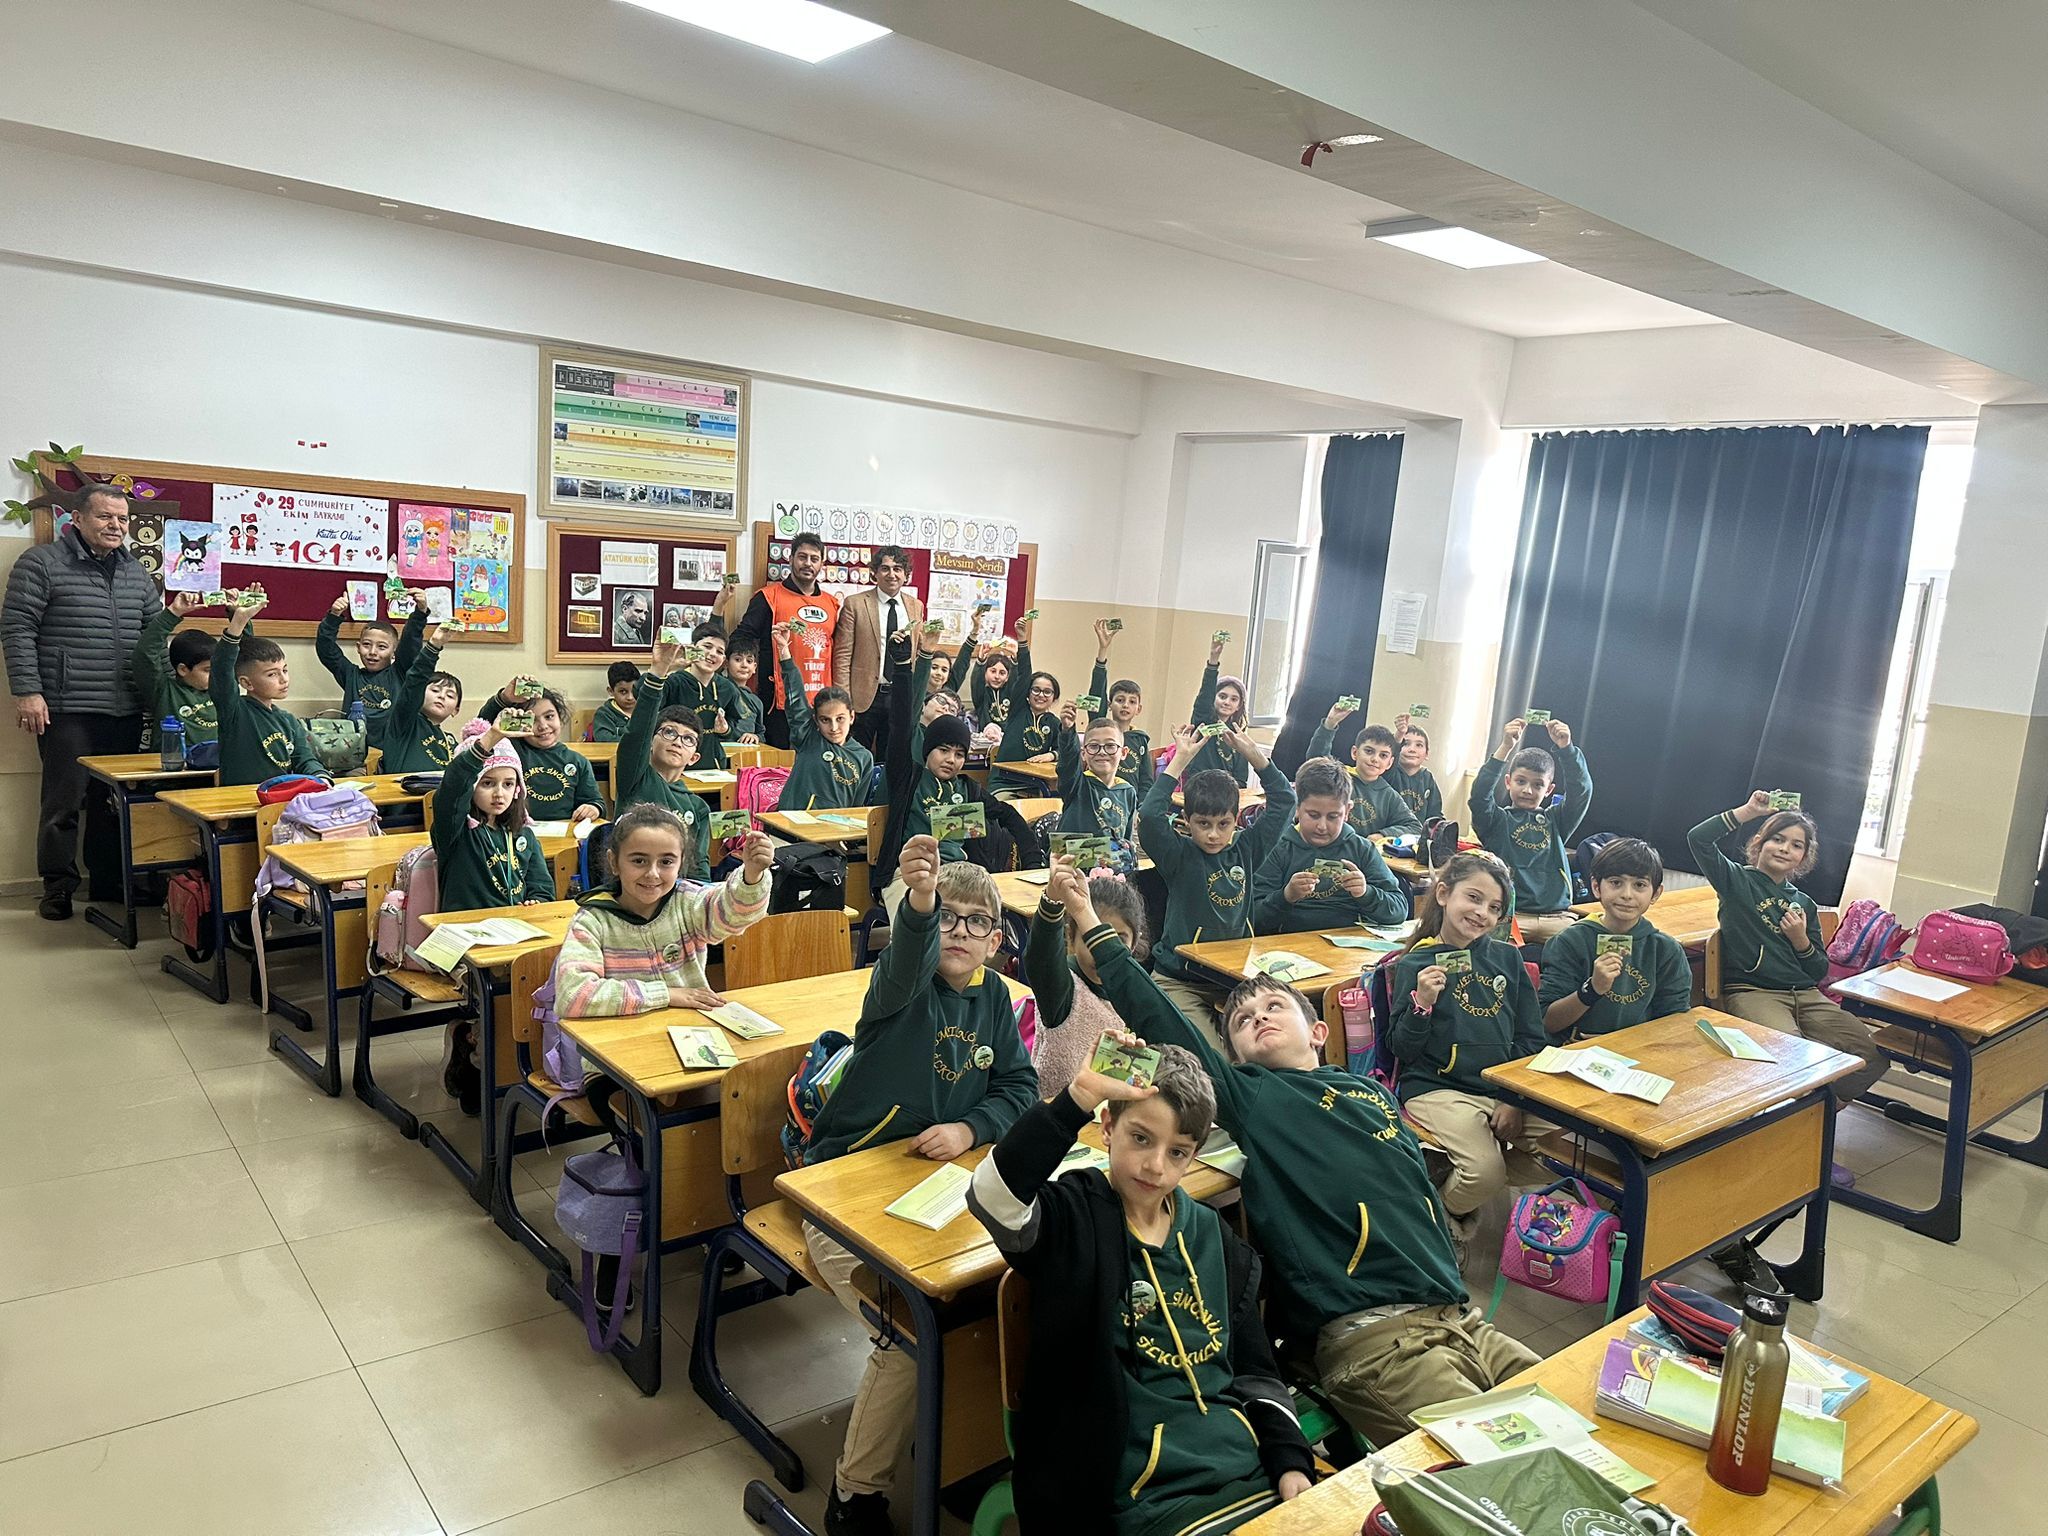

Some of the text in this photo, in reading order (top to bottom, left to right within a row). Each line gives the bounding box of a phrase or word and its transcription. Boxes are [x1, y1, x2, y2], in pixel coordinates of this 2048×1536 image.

[278, 495, 355, 511] 29 CUMHURİYET
[283, 510, 345, 521] EKİM BAYRAMI
[809, 512, 819, 527] 10
[833, 513, 844, 527] 20
[857, 515, 866, 530] 30
[901, 519, 911, 533] 50
[924, 521, 933, 536] 60
[143, 531, 151, 539] 4
[315, 528, 362, 542] Kutlu Olsun
[986, 529, 995, 540] 90
[143, 560, 151, 568] 8
[936, 553, 1004, 573] Mevsim Şeridi
[1732, 1376, 1756, 1467] DUNLOP
